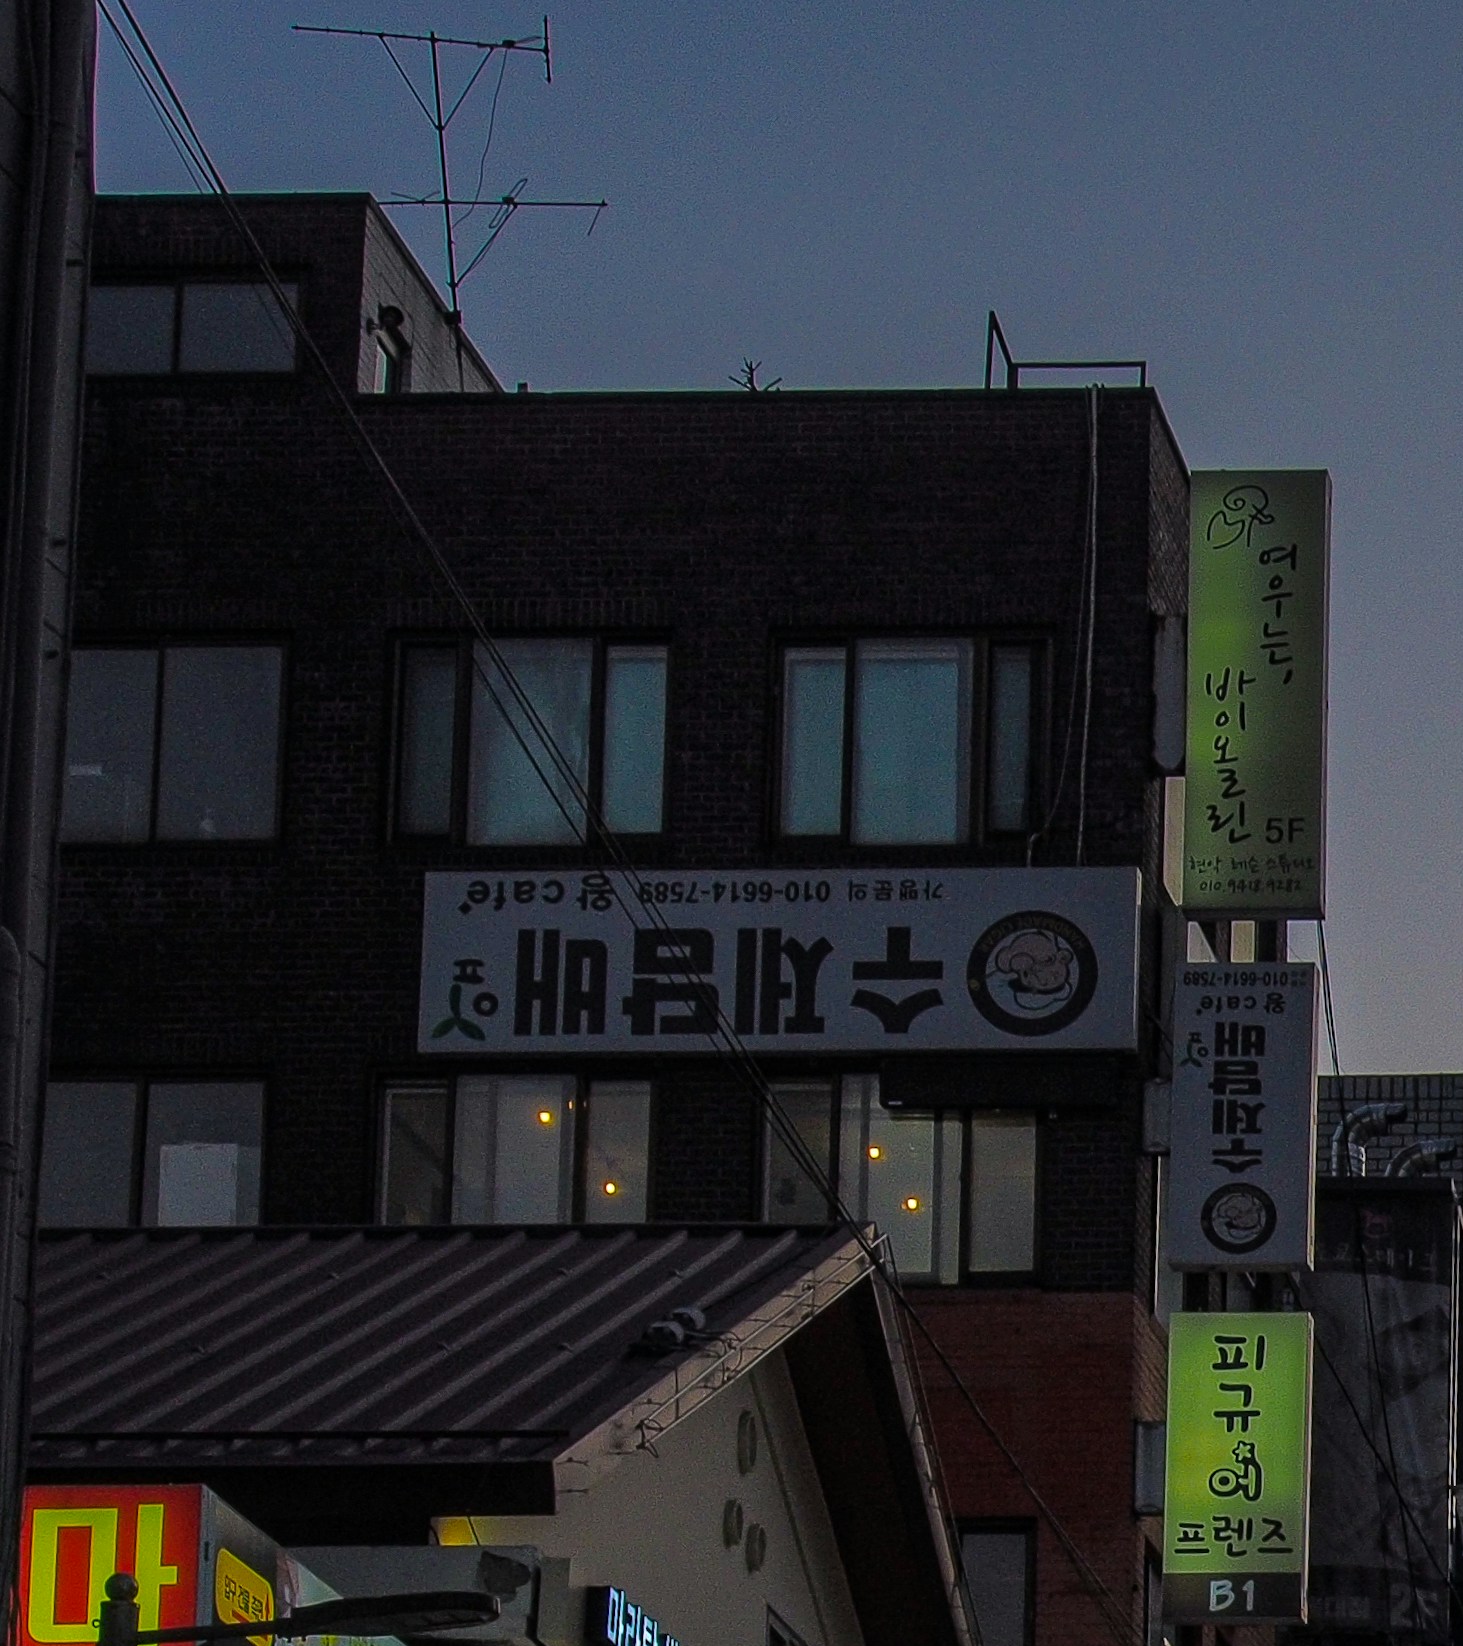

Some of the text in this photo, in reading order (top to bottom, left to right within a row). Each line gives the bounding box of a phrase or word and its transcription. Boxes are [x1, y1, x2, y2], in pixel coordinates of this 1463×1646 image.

[1206, 666, 1255, 844] 바이올린
[1266, 817, 1305, 843] 5F
[577, 874, 615, 913] 왕
[637, 879, 946, 904] 가맹문의 010-6614-7589
[513, 927, 945, 1036] 수제담배
[1184, 971, 1288, 987] 010-6614-7589
[1209, 1021, 1266, 1174] 수제담배
[1174, 1516, 1293, 1556] 프렌즈
[1208, 1580, 1255, 1613] B1
